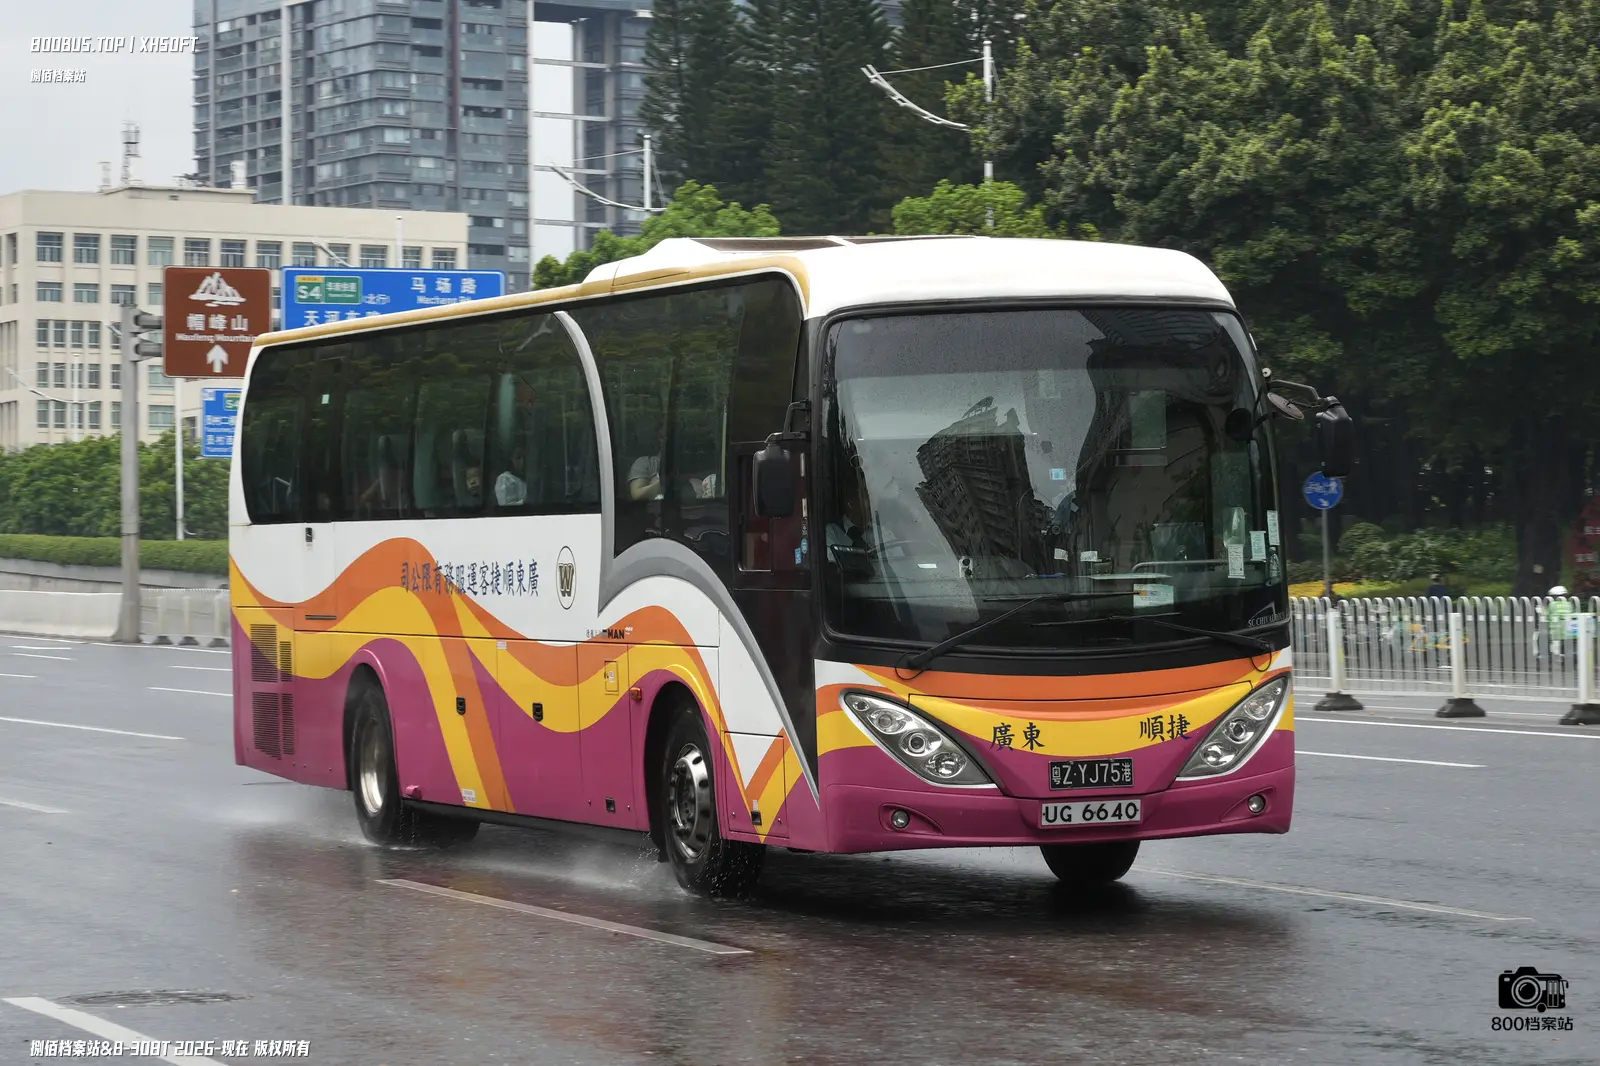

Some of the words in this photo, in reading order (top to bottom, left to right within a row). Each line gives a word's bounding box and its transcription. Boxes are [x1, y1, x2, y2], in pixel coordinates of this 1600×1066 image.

[297, 285, 322, 299] S4
[410, 277, 477, 294] 马场路
[607, 628, 625, 640] MAN
[990, 722, 1045, 751] 廣東
[1139, 713, 1191, 742] 順捷
[1045, 805, 1072, 823] UG
[1082, 802, 1138, 822] 6640
